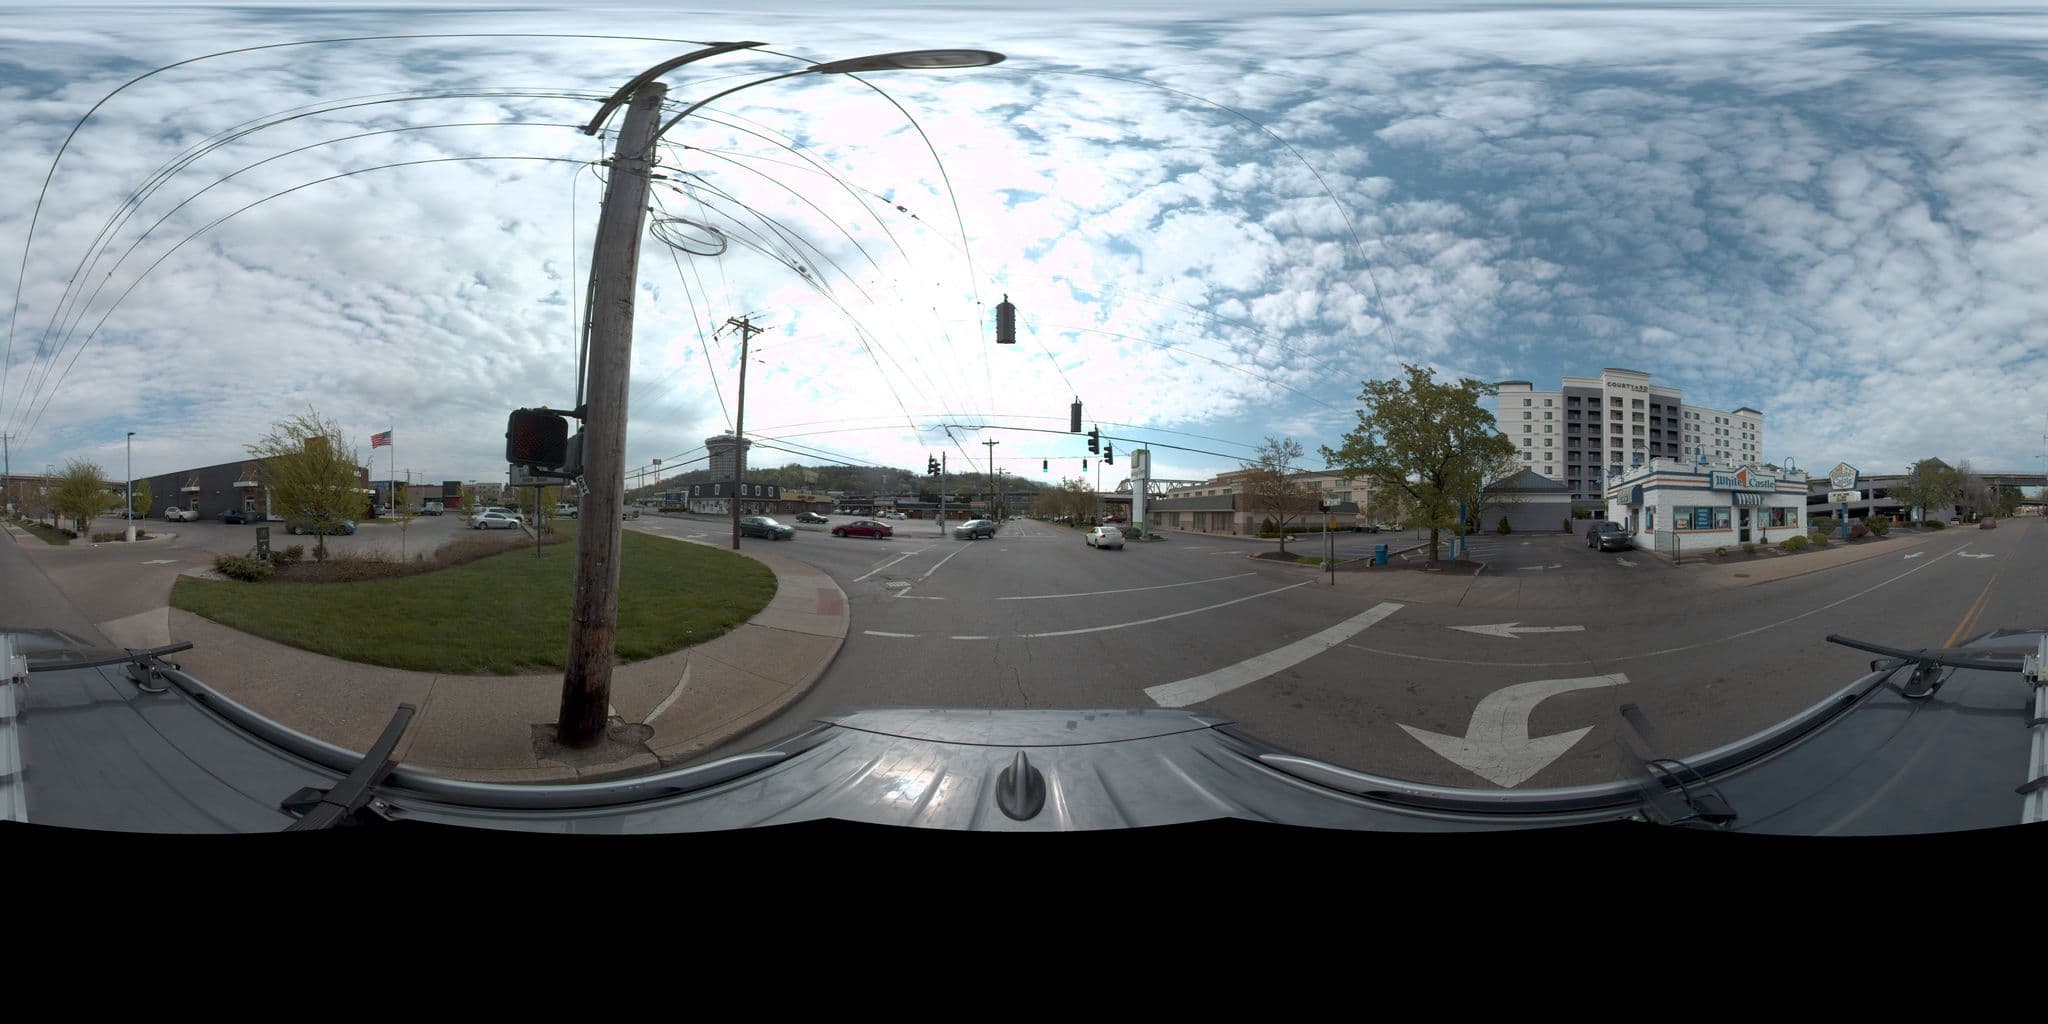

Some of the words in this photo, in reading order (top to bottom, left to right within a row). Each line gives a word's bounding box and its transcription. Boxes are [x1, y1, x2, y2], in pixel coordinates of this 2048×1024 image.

[1607, 381, 1649, 390] COURTYARD
[1716, 475, 1742, 487] White
[1748, 477, 1774, 489] Castle
